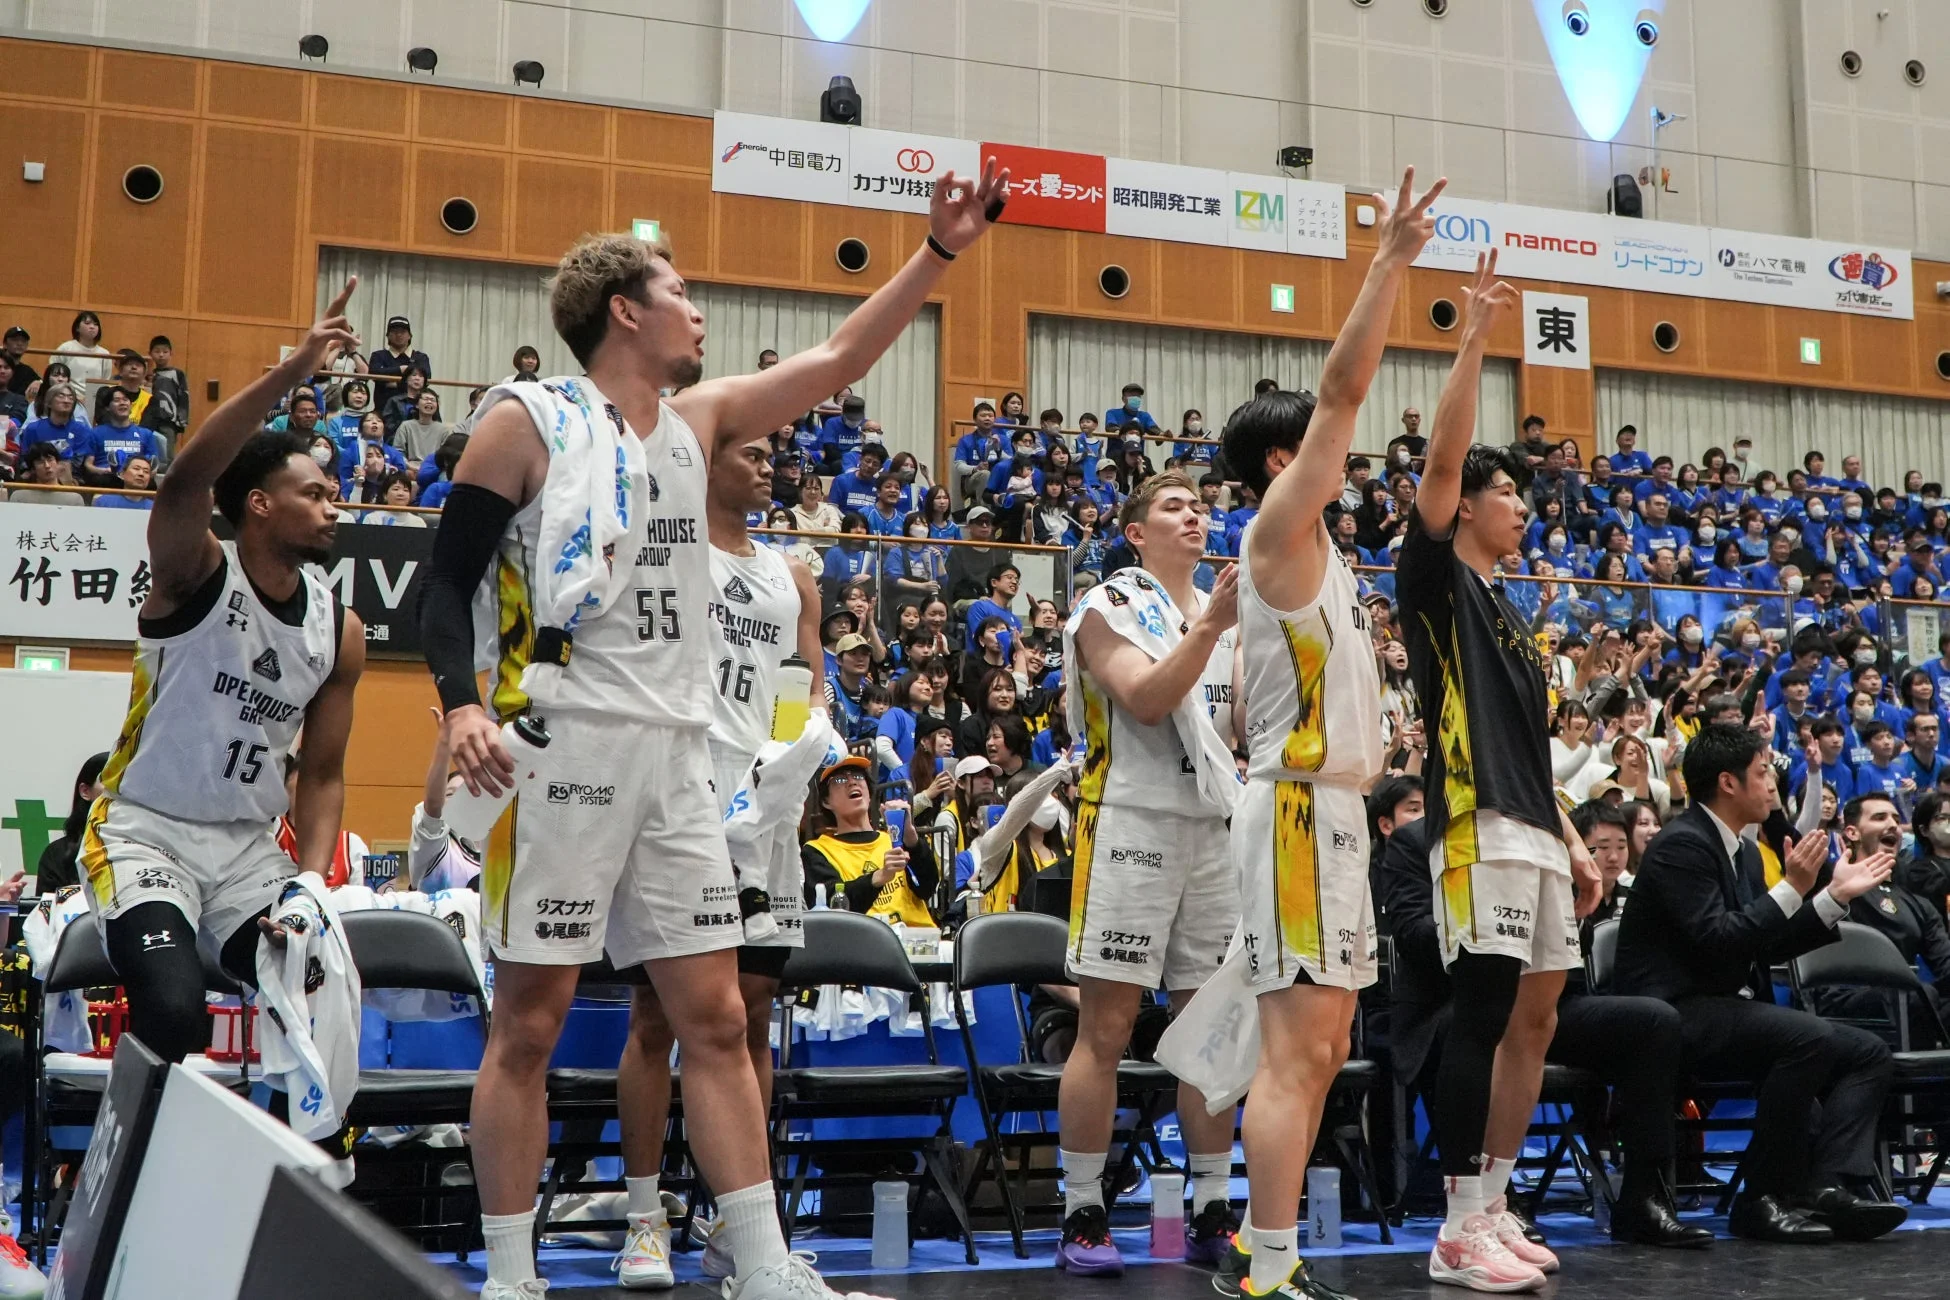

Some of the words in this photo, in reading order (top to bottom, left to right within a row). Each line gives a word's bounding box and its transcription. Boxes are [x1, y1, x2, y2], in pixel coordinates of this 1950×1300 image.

[737, 142, 768, 152] Energia
[769, 148, 841, 173] 中国電力
[853, 173, 963, 199] カナツ技建
[1113, 187, 1221, 216] 昭和開発工業
[1235, 190, 1284, 221] IZM
[1298, 229, 1339, 240] 株式会社
[1446, 246, 1477, 258] ユニコ
[1505, 232, 1597, 257] namco
[1614, 250, 1703, 277] リードコナン
[1753, 255, 1807, 274] ハマ電機
[1537, 306, 1578, 354] 東
[647, 518, 697, 544] HOUSE
[16, 530, 108, 552] 株式会社
[634, 588, 682, 642] 55
[717, 656, 756, 706] 16
[222, 736, 270, 787] 15
[569, 783, 615, 797] RYOMO
[1126, 850, 1163, 861] RYOMO
[1132, 859, 1162, 869] SYSTEMS
[373, 859, 396, 877] GO!
[703, 887, 726, 895] OPEN
[694, 912, 741, 927] 関東ホー
[552, 922, 580, 940] 尾島
[1111, 931, 1152, 947] スナガ
[1114, 948, 1140, 965] 尾島
